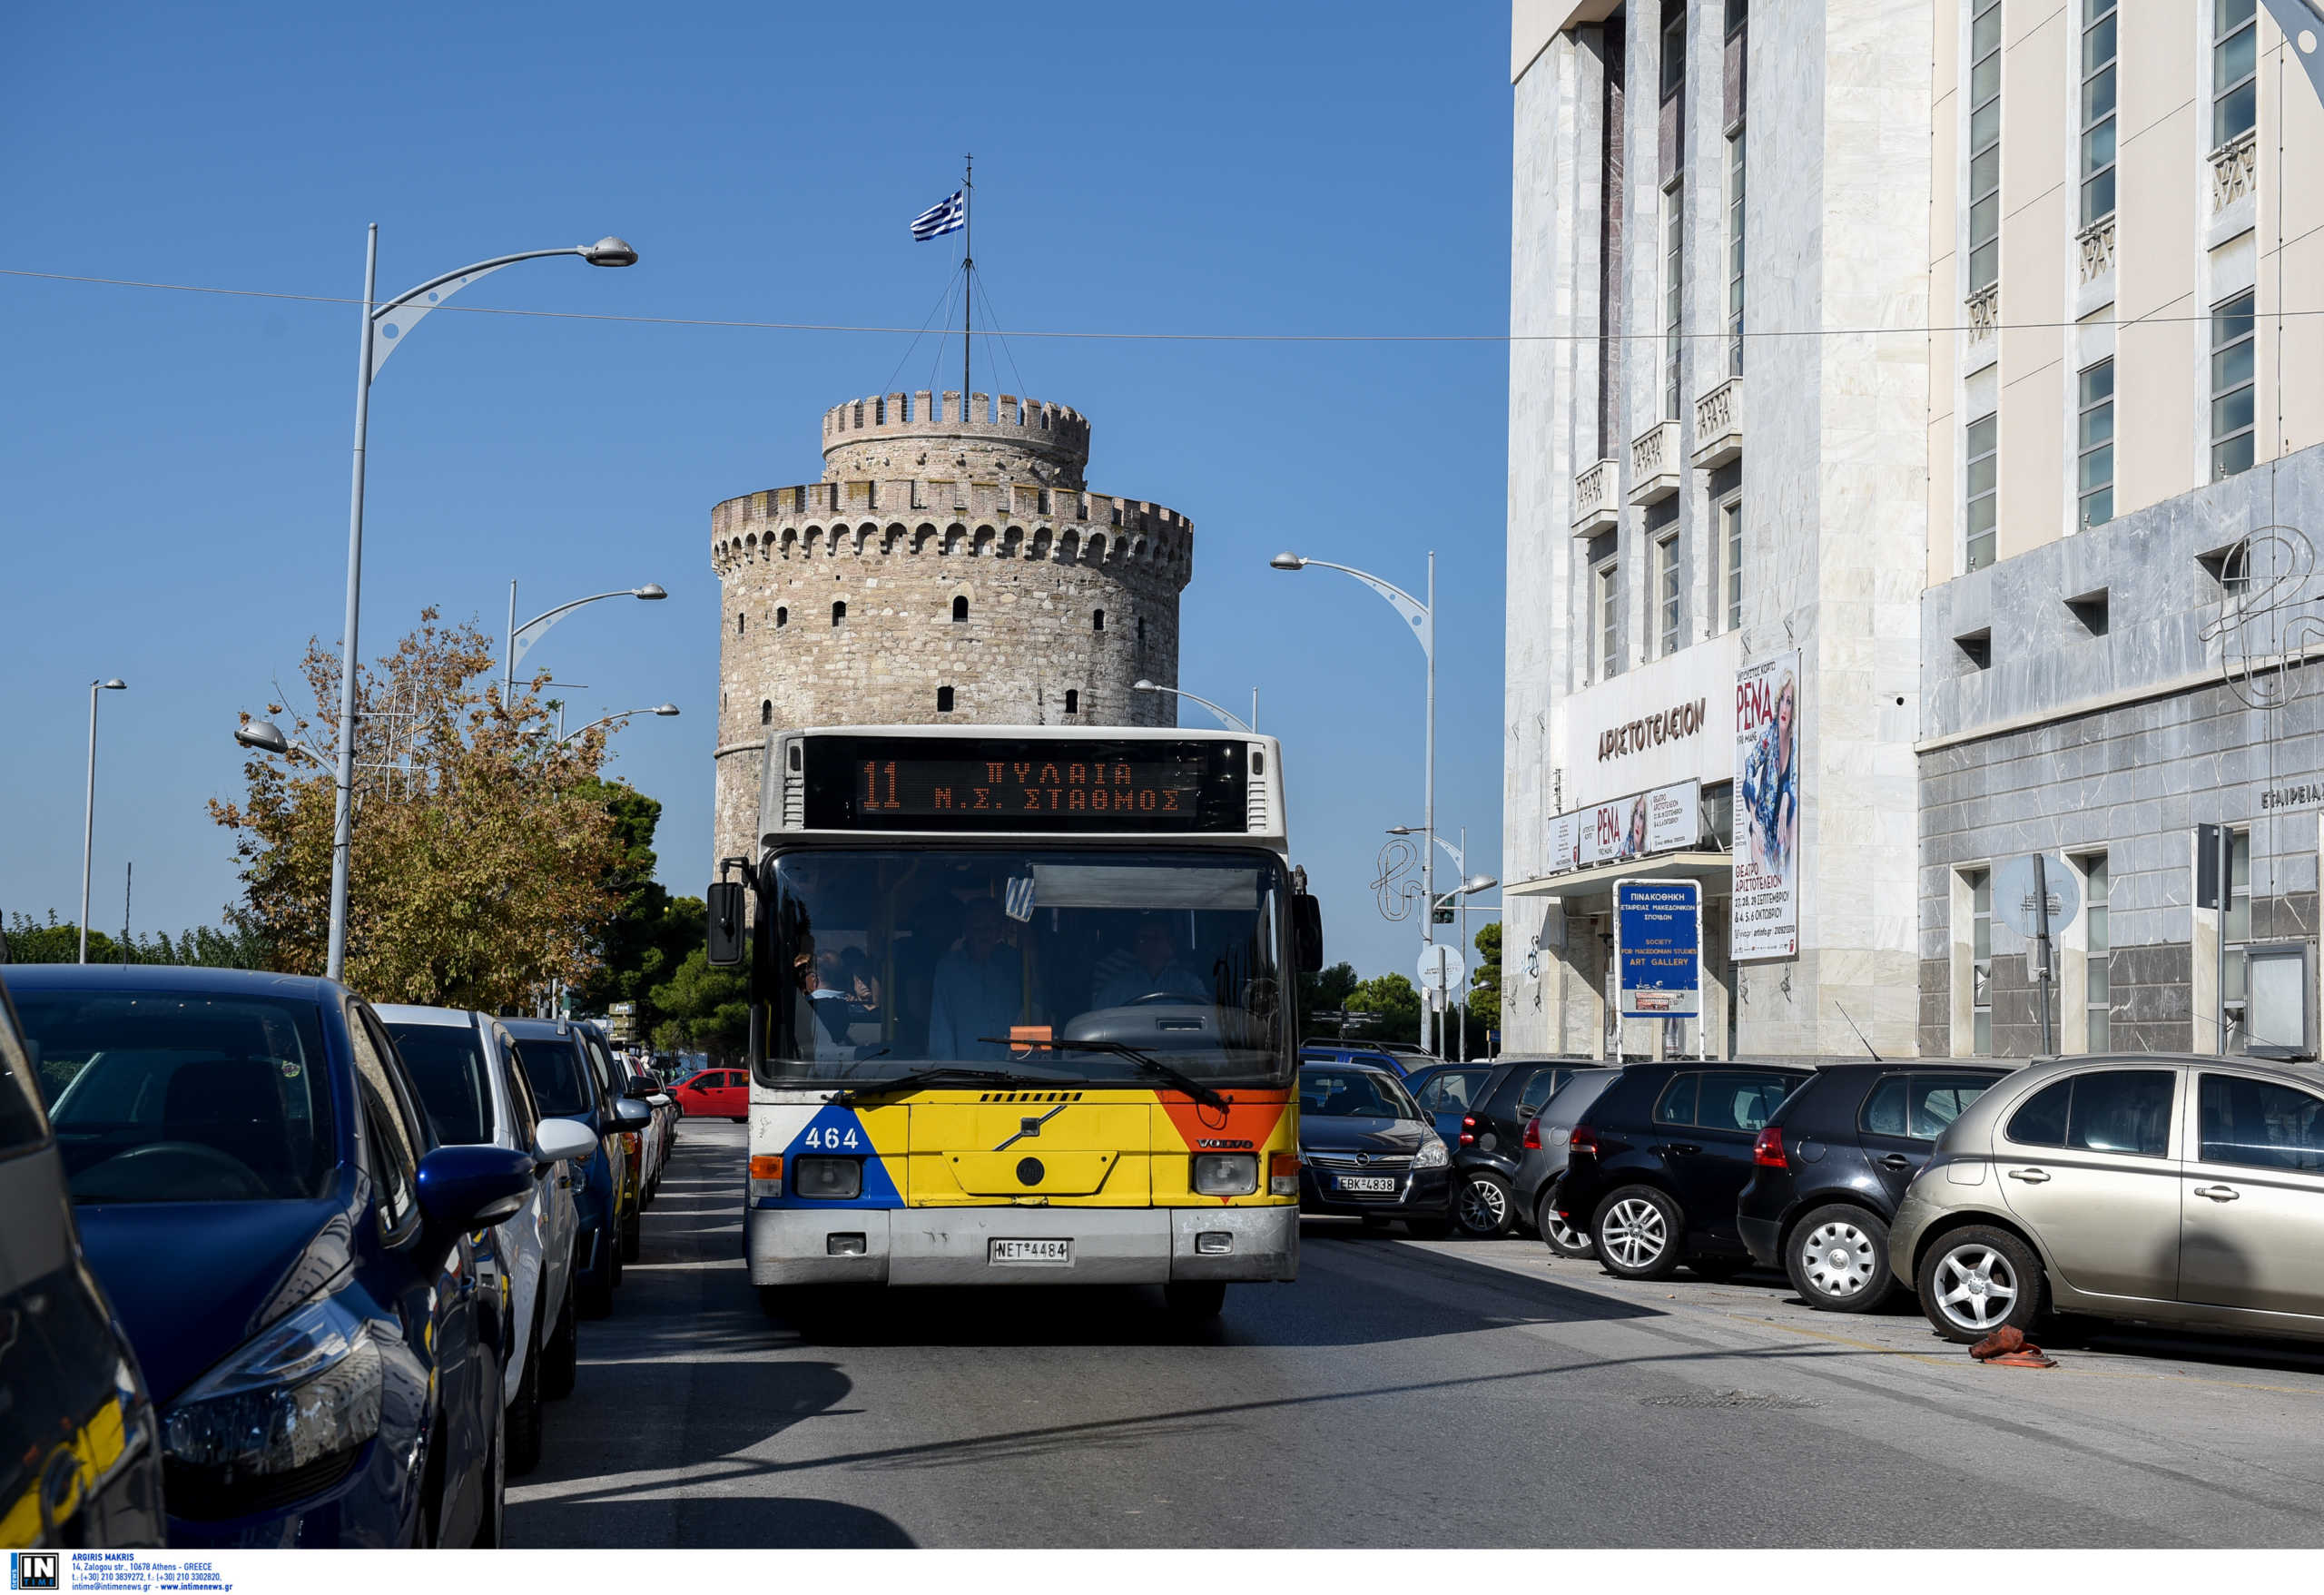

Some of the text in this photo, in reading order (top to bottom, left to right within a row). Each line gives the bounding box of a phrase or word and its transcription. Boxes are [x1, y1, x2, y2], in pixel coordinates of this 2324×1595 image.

[1737, 676, 1773, 733] ΡΕΝΑ
[1598, 697, 1706, 763] ΑΡΙΣΤΟΤΕΛΕΙΟΝ
[863, 762, 901, 808] 11
[985, 763, 1132, 784] ΠΥΛΑΙΑ
[934, 787, 1180, 811] Ν.Σ. ΣΤΑΘΜΟΣ
[2260, 783, 2324, 809] ΕΤΑΙΡΕΙΑ
[1598, 805, 1620, 846] ΡΕΝΑ
[1736, 862, 1758, 878] ΘΕΑΤΡΟ
[1735, 874, 1782, 891] ΑΡΙΣΤΟΤΕΛΕΙΟΝ
[1630, 893, 1685, 901] ΠΙΝΑΚΟΘΗΚΗ
[805, 1127, 859, 1149] 464
[1196, 1138, 1254, 1149] VOLVO
